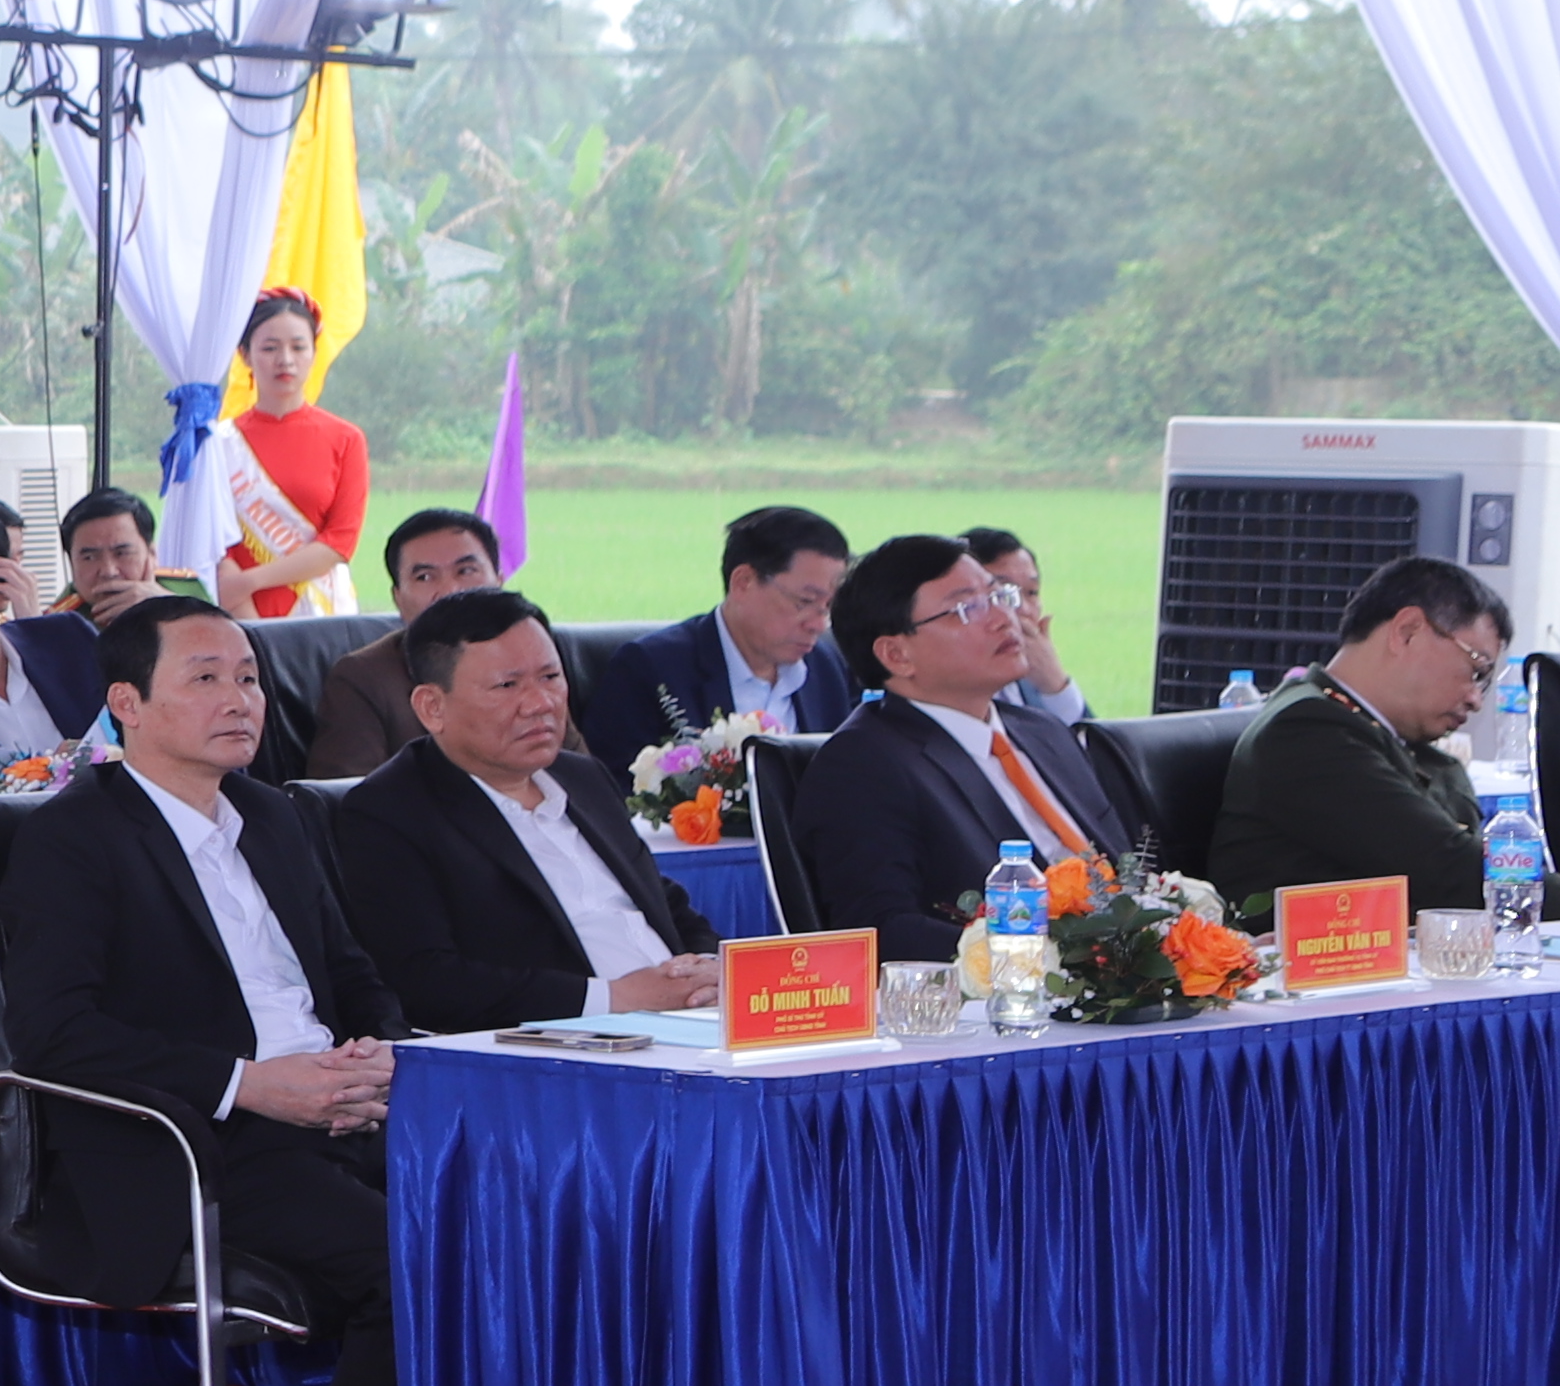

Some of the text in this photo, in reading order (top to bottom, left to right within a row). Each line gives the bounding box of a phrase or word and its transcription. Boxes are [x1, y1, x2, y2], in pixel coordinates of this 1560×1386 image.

[1302, 434, 1376, 449] SAMMAX
[1490, 853, 1534, 867] laVie
[1297, 930, 1345, 957] NGUYỄN
[1346, 931, 1369, 950] VĂN
[780, 971, 820, 986] ĐỒNG CHÍ
[750, 980, 850, 1014] ĐỖ MINH TUẤN
